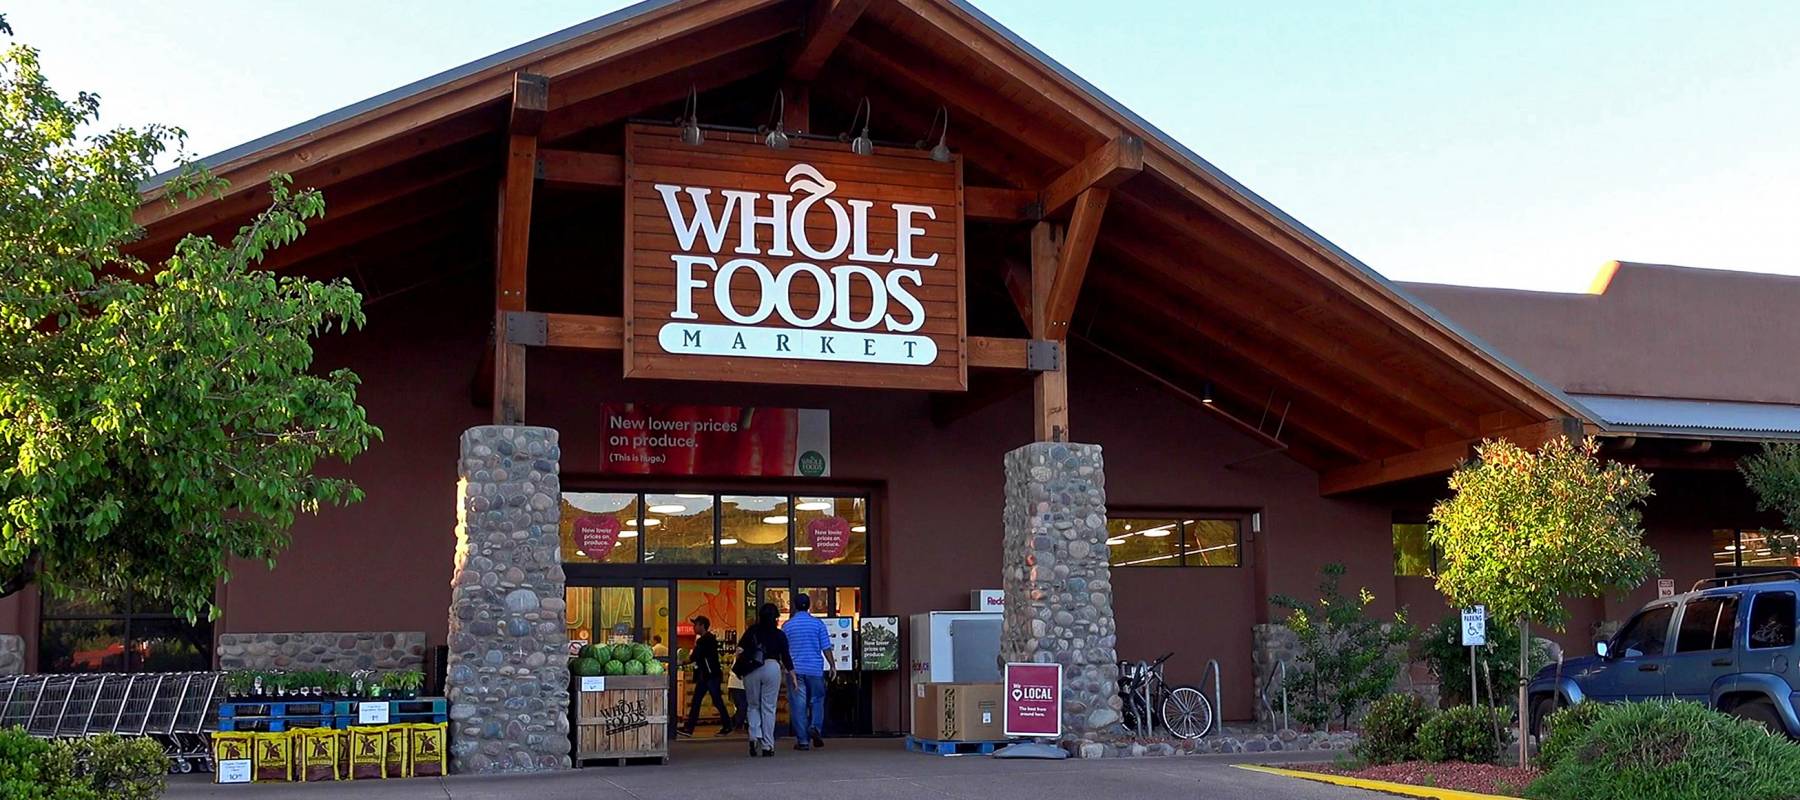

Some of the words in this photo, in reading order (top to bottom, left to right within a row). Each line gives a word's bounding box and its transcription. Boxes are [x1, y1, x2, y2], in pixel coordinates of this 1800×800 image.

[654, 163, 939, 266] WHOLE
[670, 254, 926, 333] FOODS
[682, 329, 918, 358] MARKET
[610, 416, 645, 429] New
[648, 416, 690, 431] lower
[694, 418, 738, 434] prices
[609, 436, 629, 446] on
[633, 434, 699, 449] produce.
[609, 453, 630, 463] (This
[632, 454, 639, 462] is
[641, 454, 666, 464] huge.)
[1024, 687, 1053, 699] LOCAL
[600, 699, 646, 720] WHOLE
[605, 712, 645, 731] FOODS
